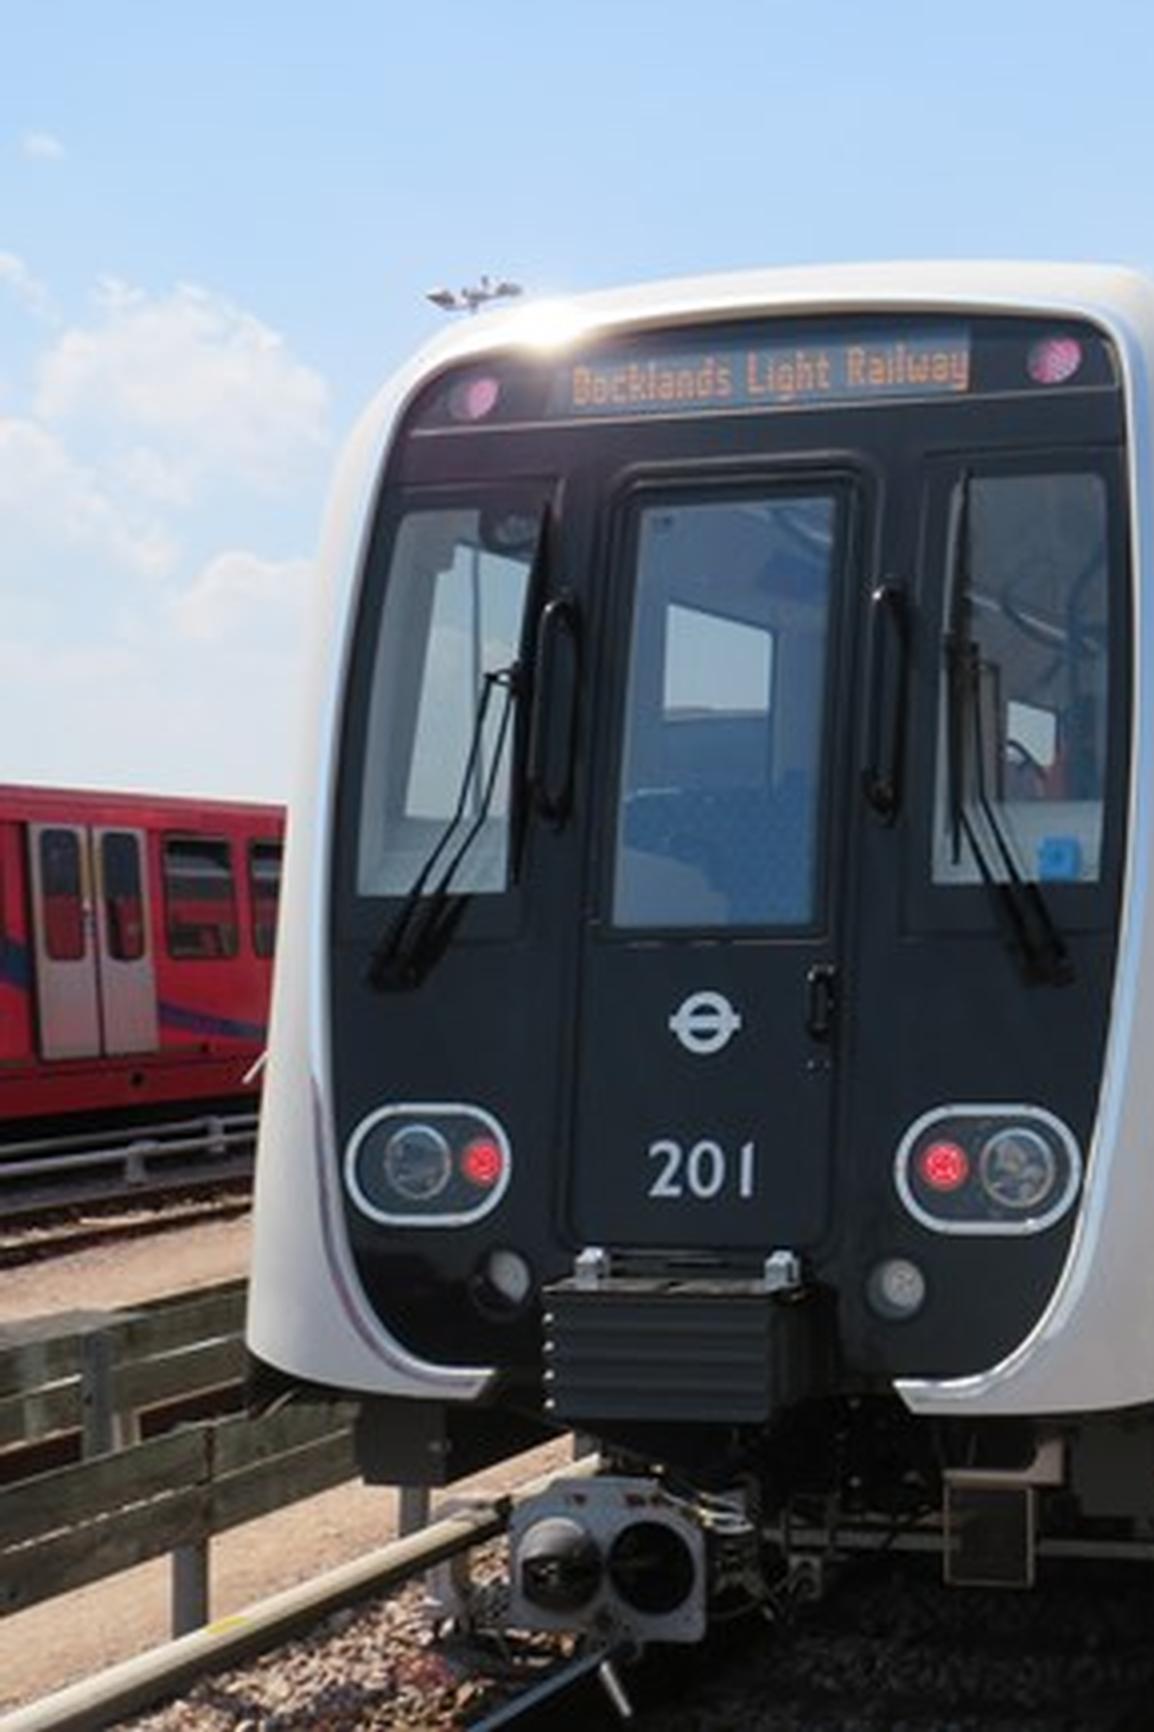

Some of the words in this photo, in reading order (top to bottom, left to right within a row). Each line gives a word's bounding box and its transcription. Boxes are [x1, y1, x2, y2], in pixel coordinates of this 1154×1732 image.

[573, 356, 731, 405] Docklands
[747, 351, 831, 401] Light
[847, 342, 969, 392] Railway
[648, 1140, 754, 1197] 201
